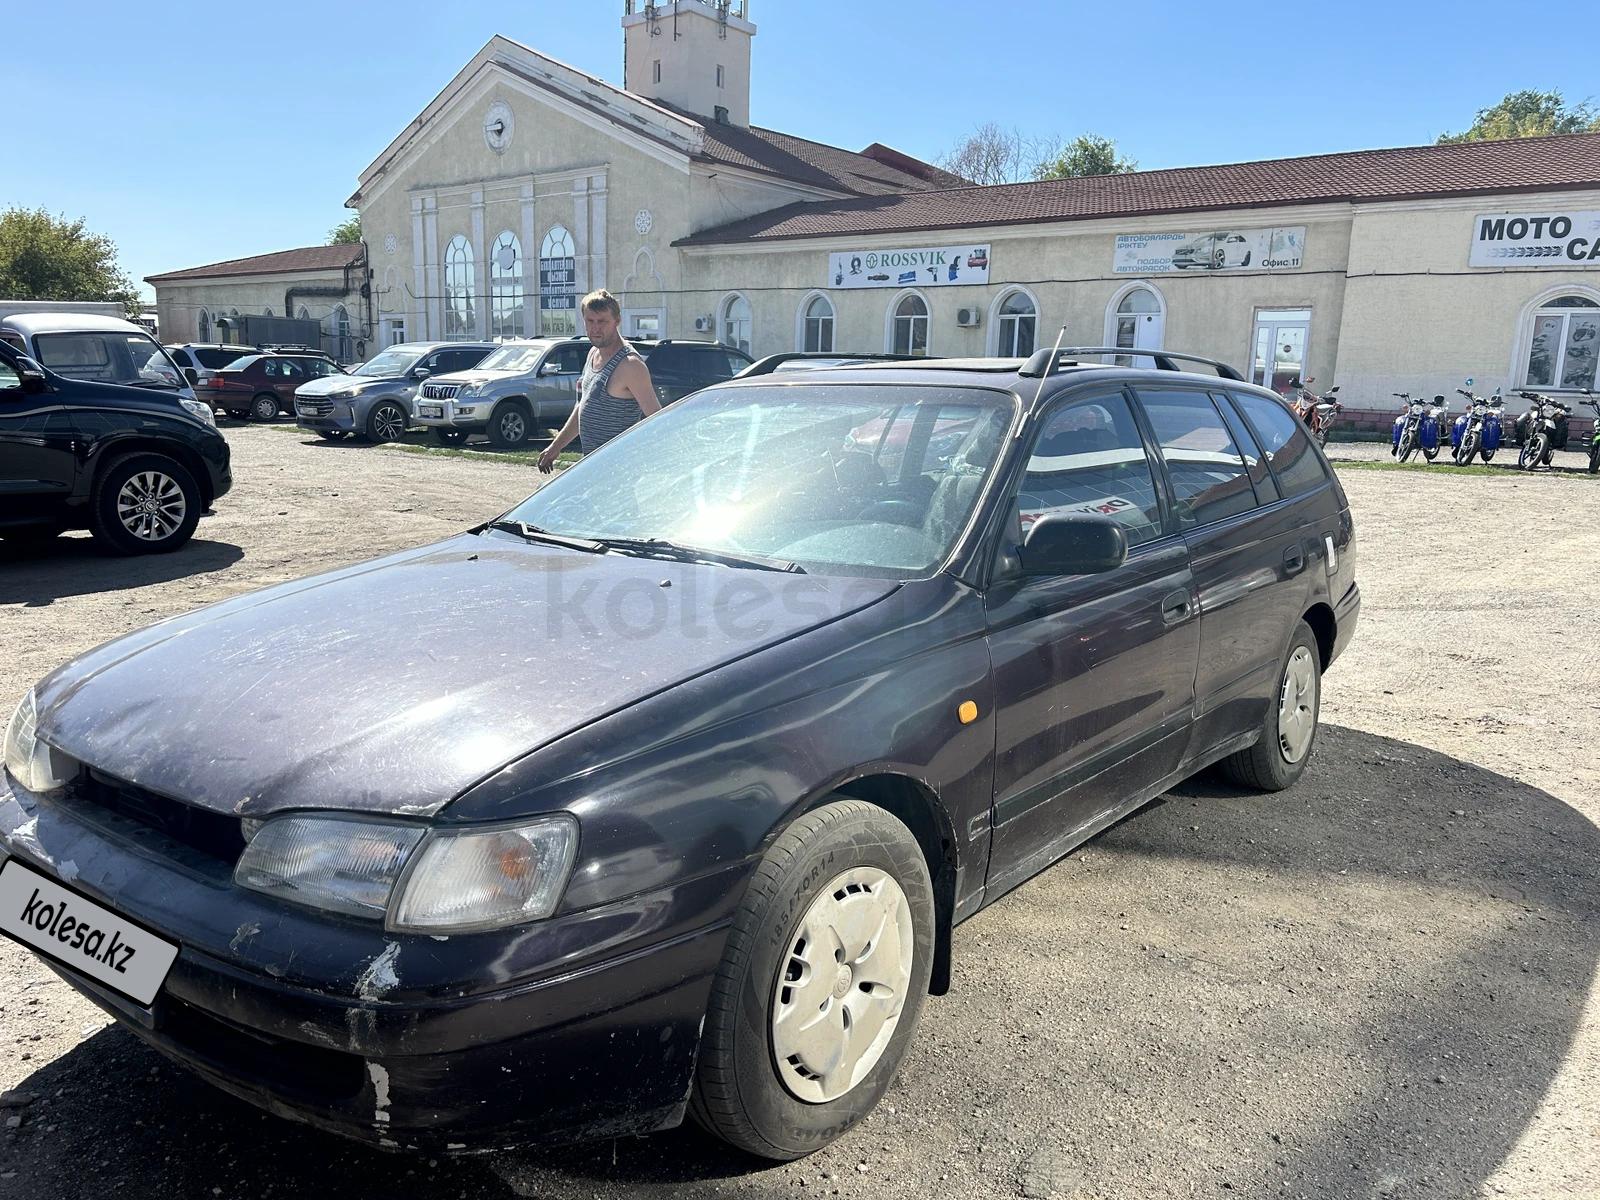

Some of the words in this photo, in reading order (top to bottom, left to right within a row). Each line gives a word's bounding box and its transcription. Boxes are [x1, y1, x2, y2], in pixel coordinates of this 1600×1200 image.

[1480, 216, 1572, 240] MOTO
[881, 251, 946, 267] ROSSVIK
[1262, 259, 1289, 268] Офис
[1291, 258, 1299, 266] 11
[1116, 264, 1170, 272] АВТОКРАСОК
